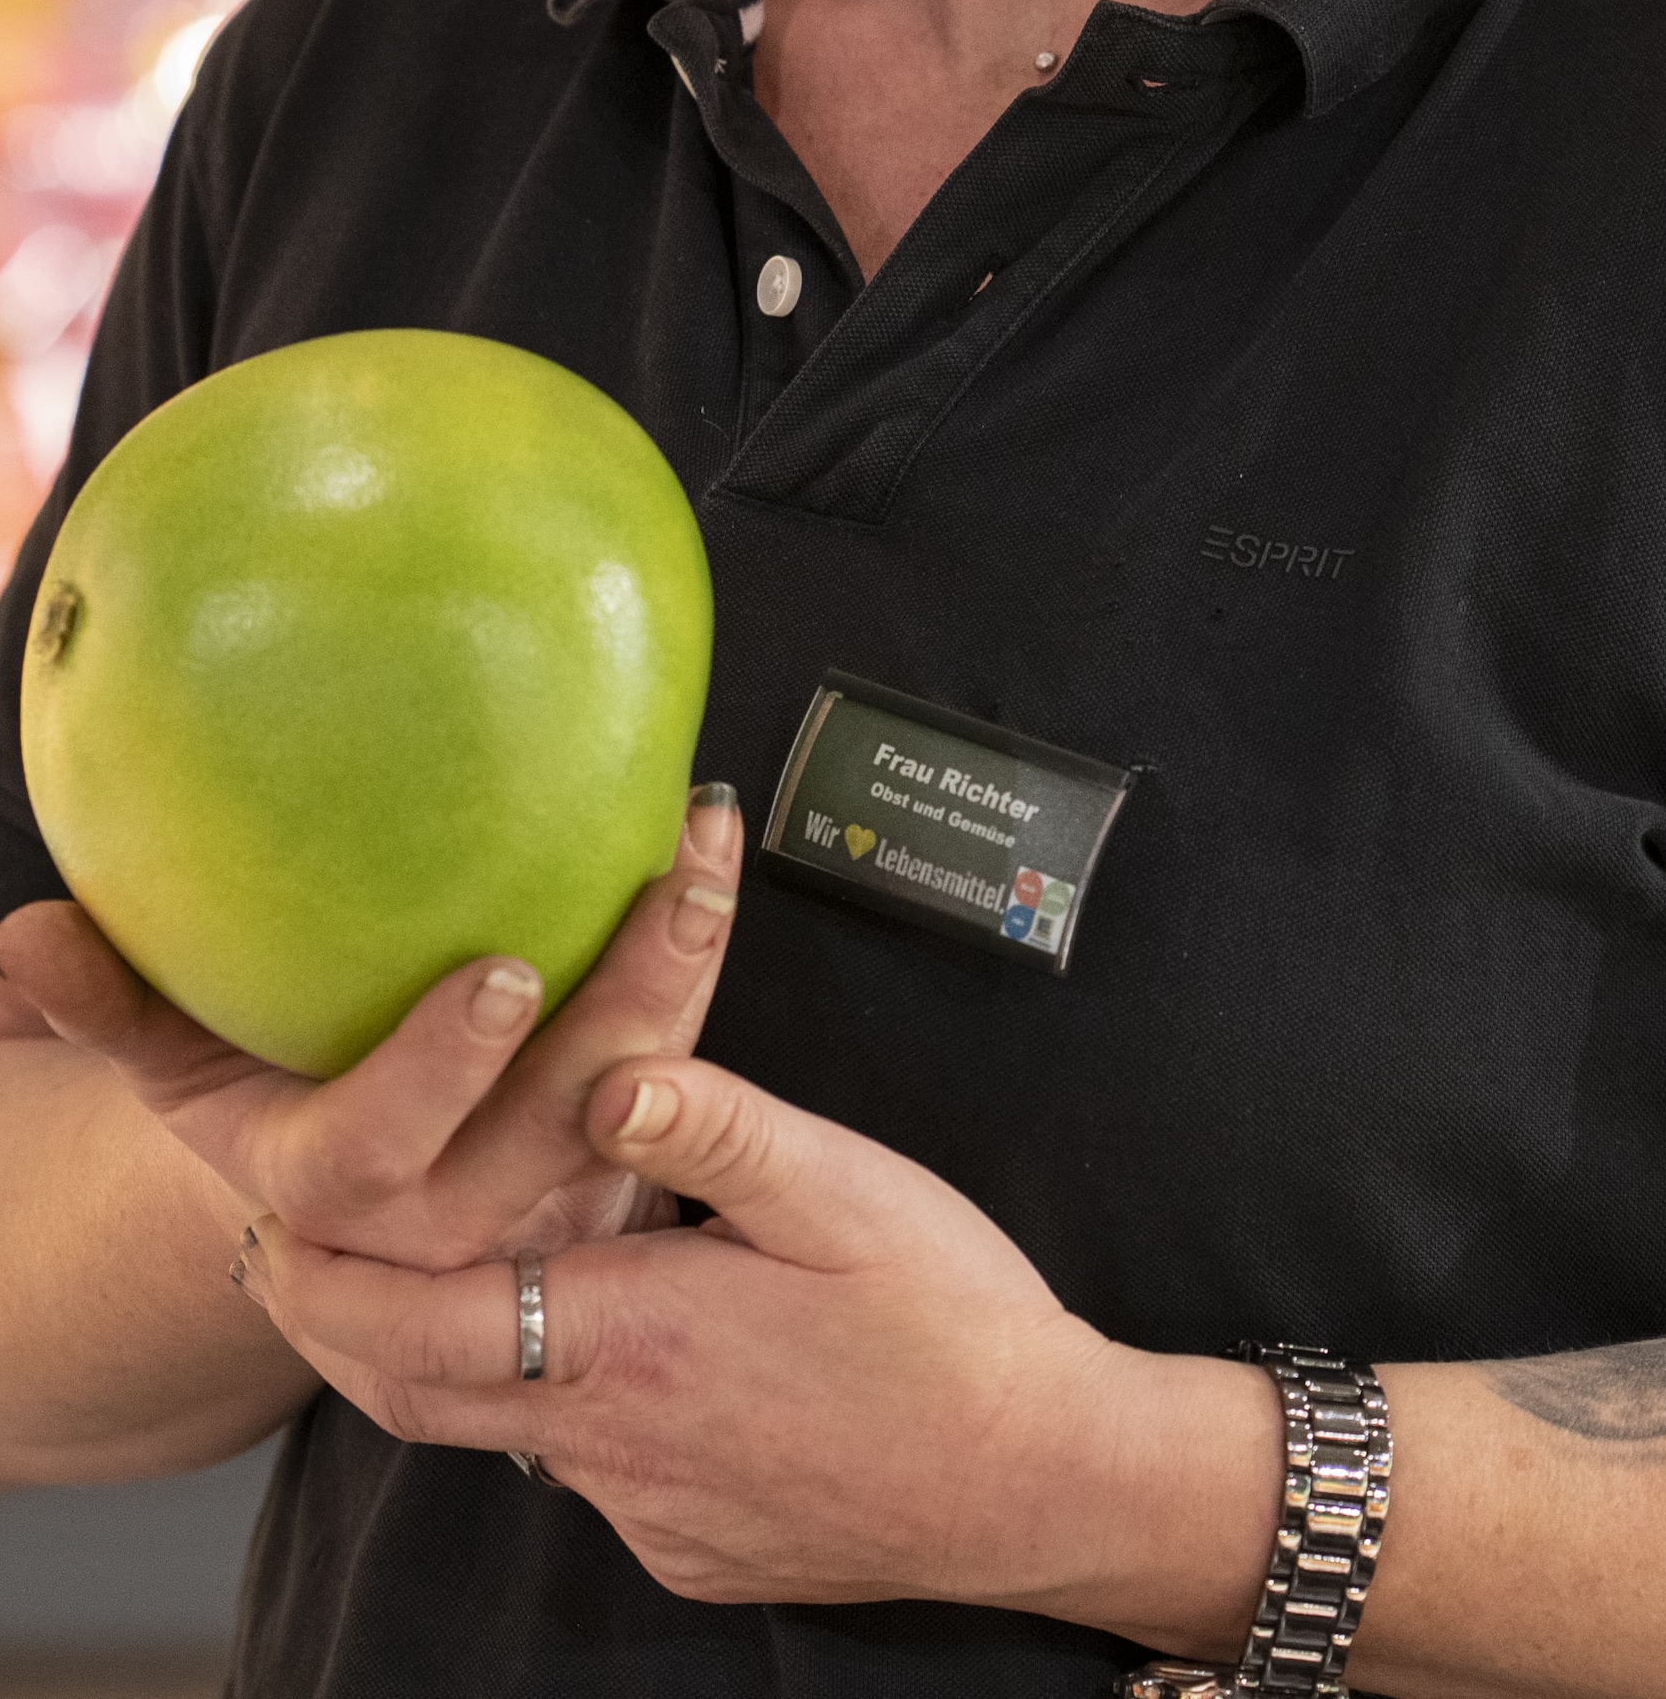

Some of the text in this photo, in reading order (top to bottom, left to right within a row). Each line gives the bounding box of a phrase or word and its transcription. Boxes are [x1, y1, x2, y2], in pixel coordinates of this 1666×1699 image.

[1201, 525, 1355, 578] ESPRIT
[870, 782, 1016, 848] Obst und Gemüse
[873, 743, 1040, 823] Frau Richter
[804, 810, 1005, 915] Wir Lebensmittel.
